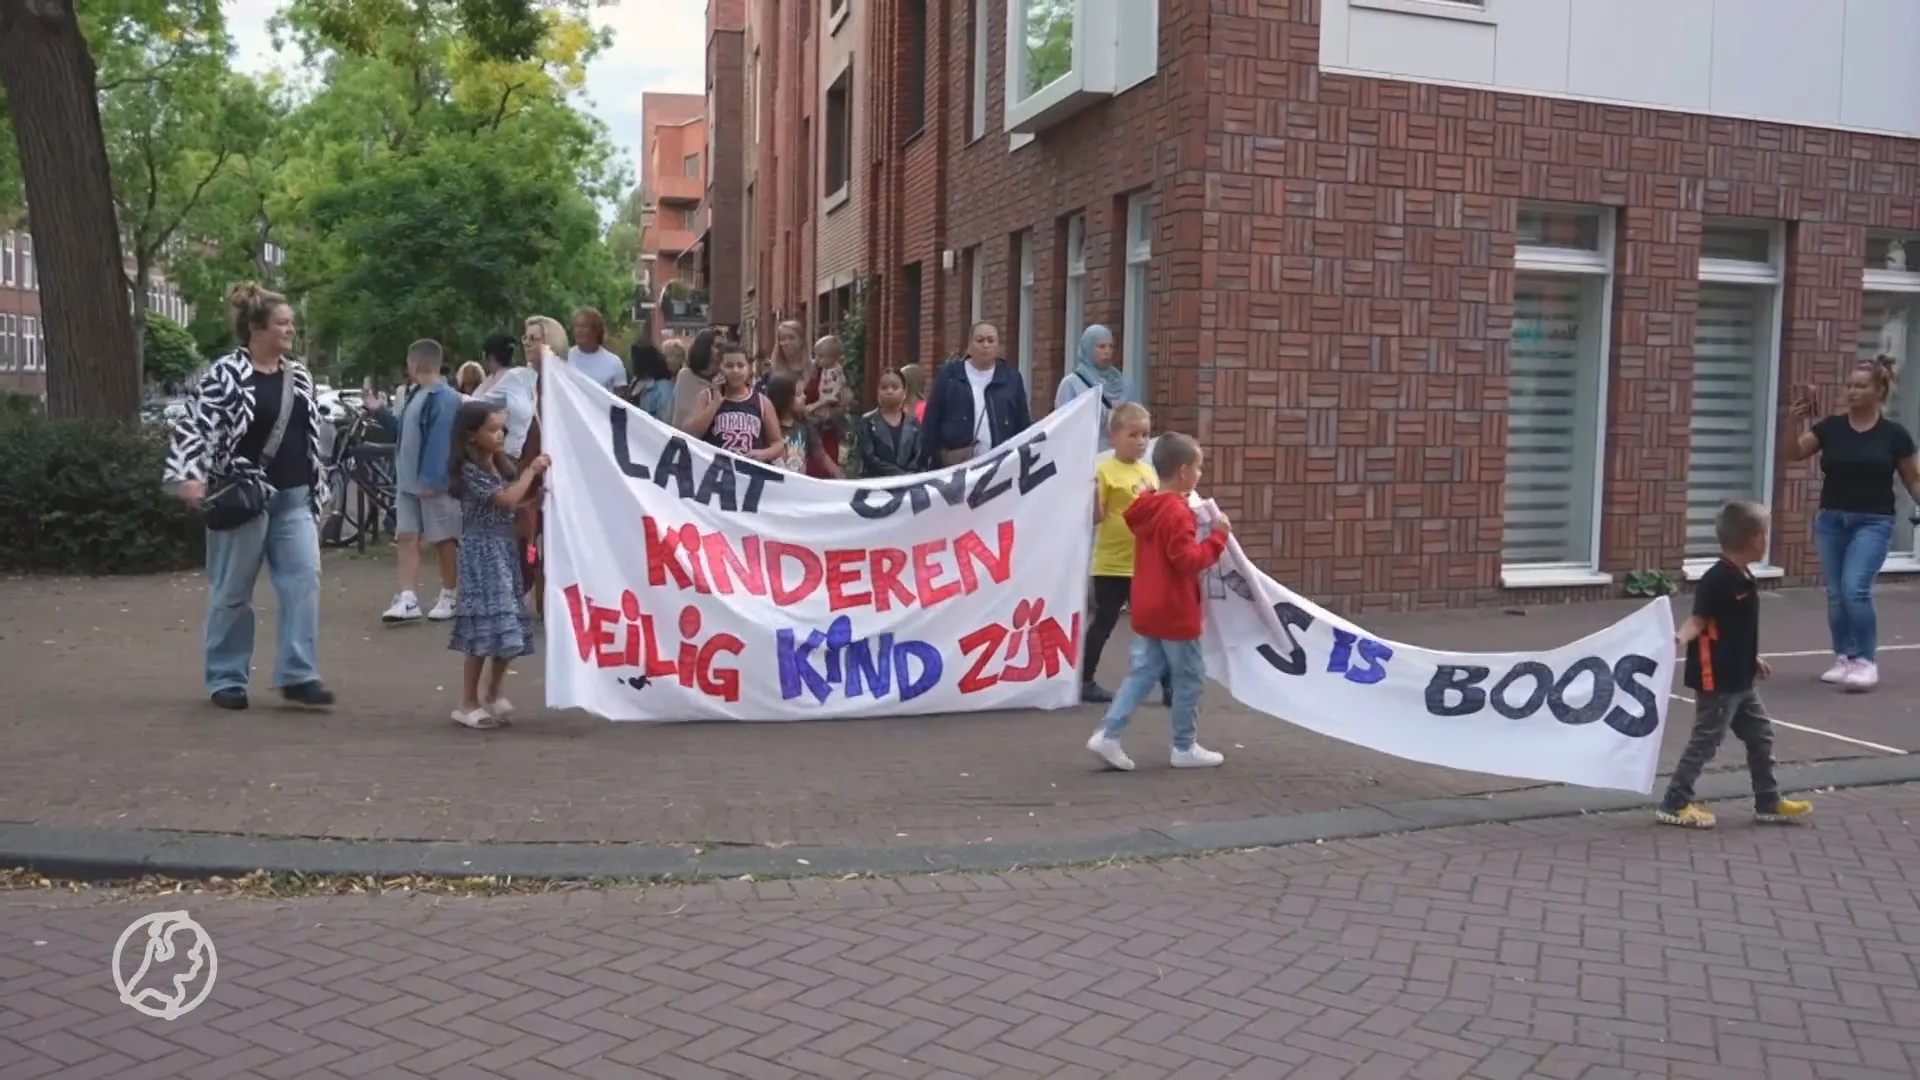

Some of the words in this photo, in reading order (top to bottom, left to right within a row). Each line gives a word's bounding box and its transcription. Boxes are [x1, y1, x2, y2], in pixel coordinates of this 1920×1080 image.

[610, 405, 784, 513] LAAT
[850, 431, 1057, 518] ONZE
[722, 430, 753, 455] 23
[1326, 627, 1393, 684] IS
[1424, 653, 1659, 738] BOOS
